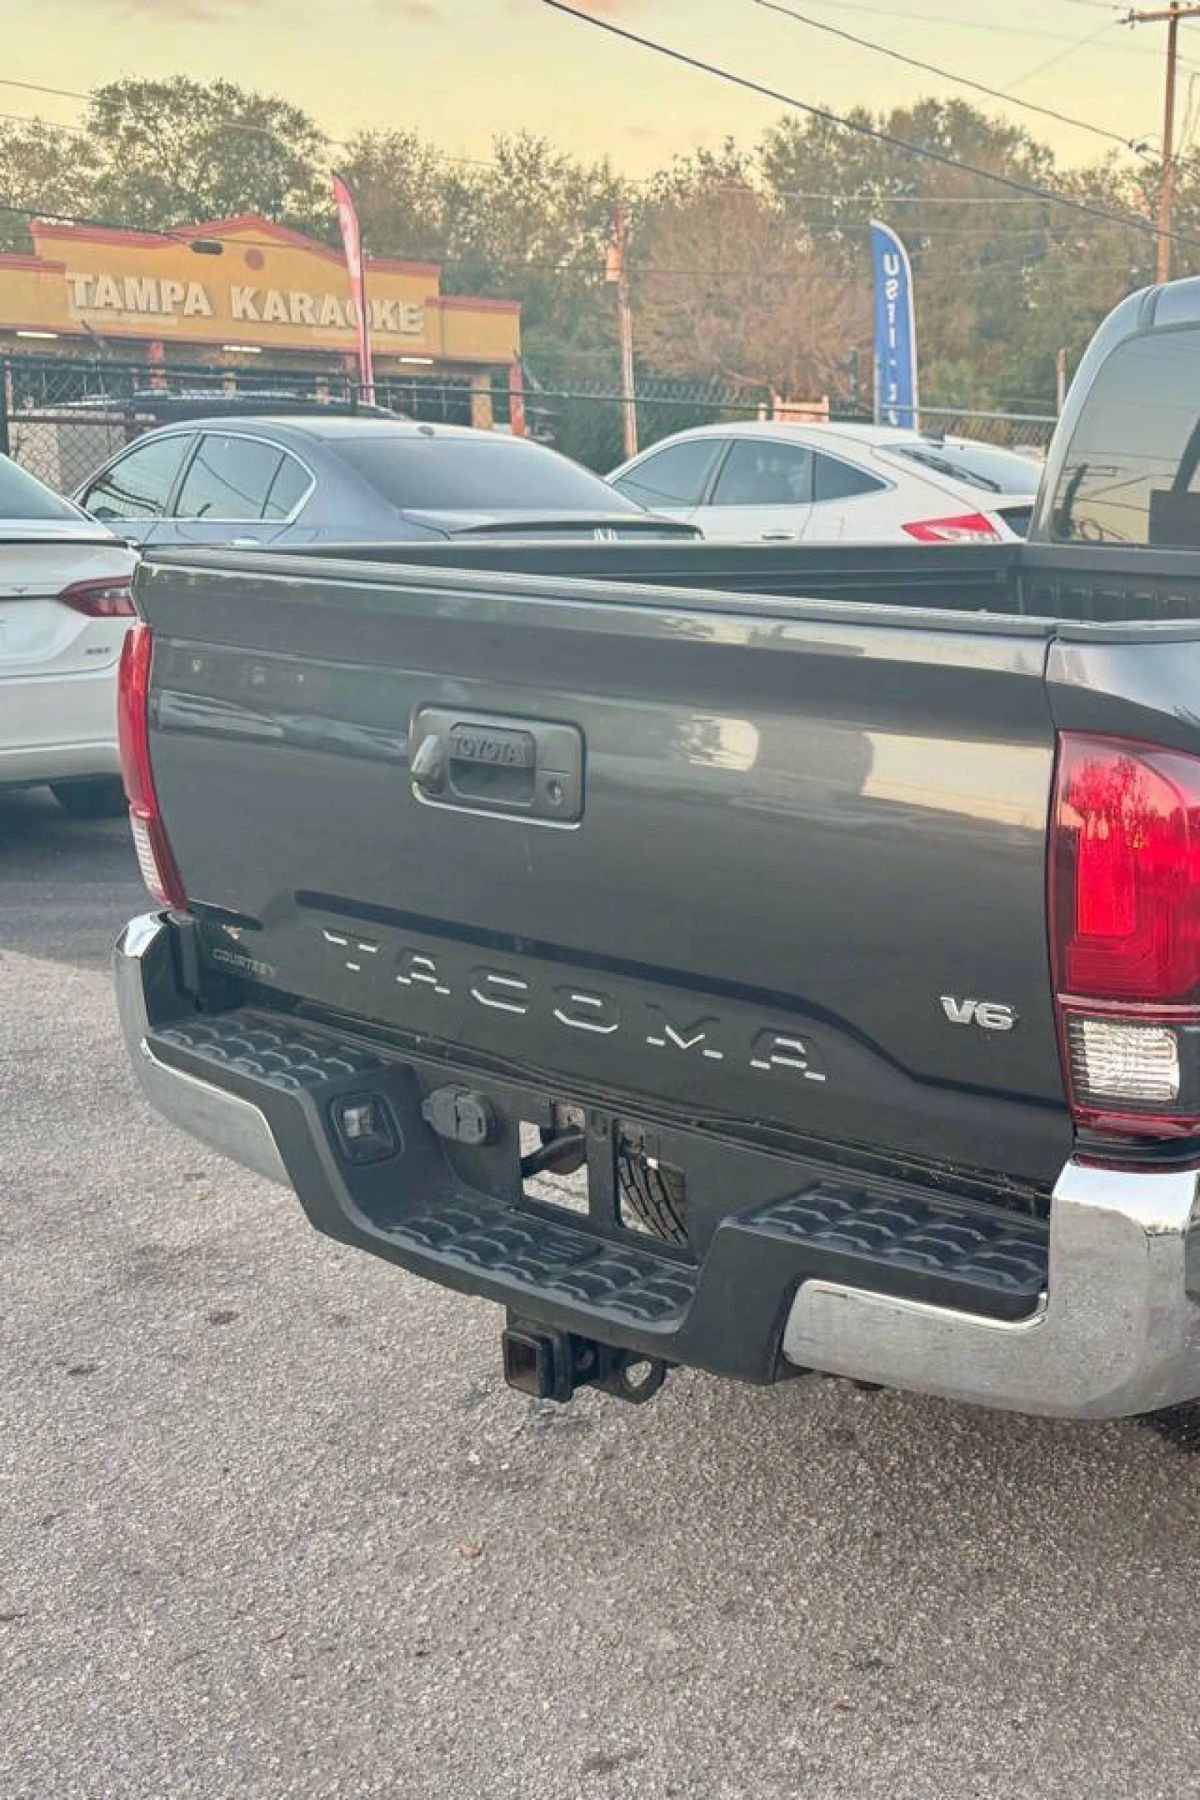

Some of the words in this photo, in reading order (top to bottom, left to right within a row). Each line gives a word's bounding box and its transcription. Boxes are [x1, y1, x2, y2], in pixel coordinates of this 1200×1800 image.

[66, 272, 212, 317] TAMPA
[451, 733, 529, 762] TOYOTA
[321, 928, 826, 1081] TACOMA
[940, 996, 1013, 1030] V6
